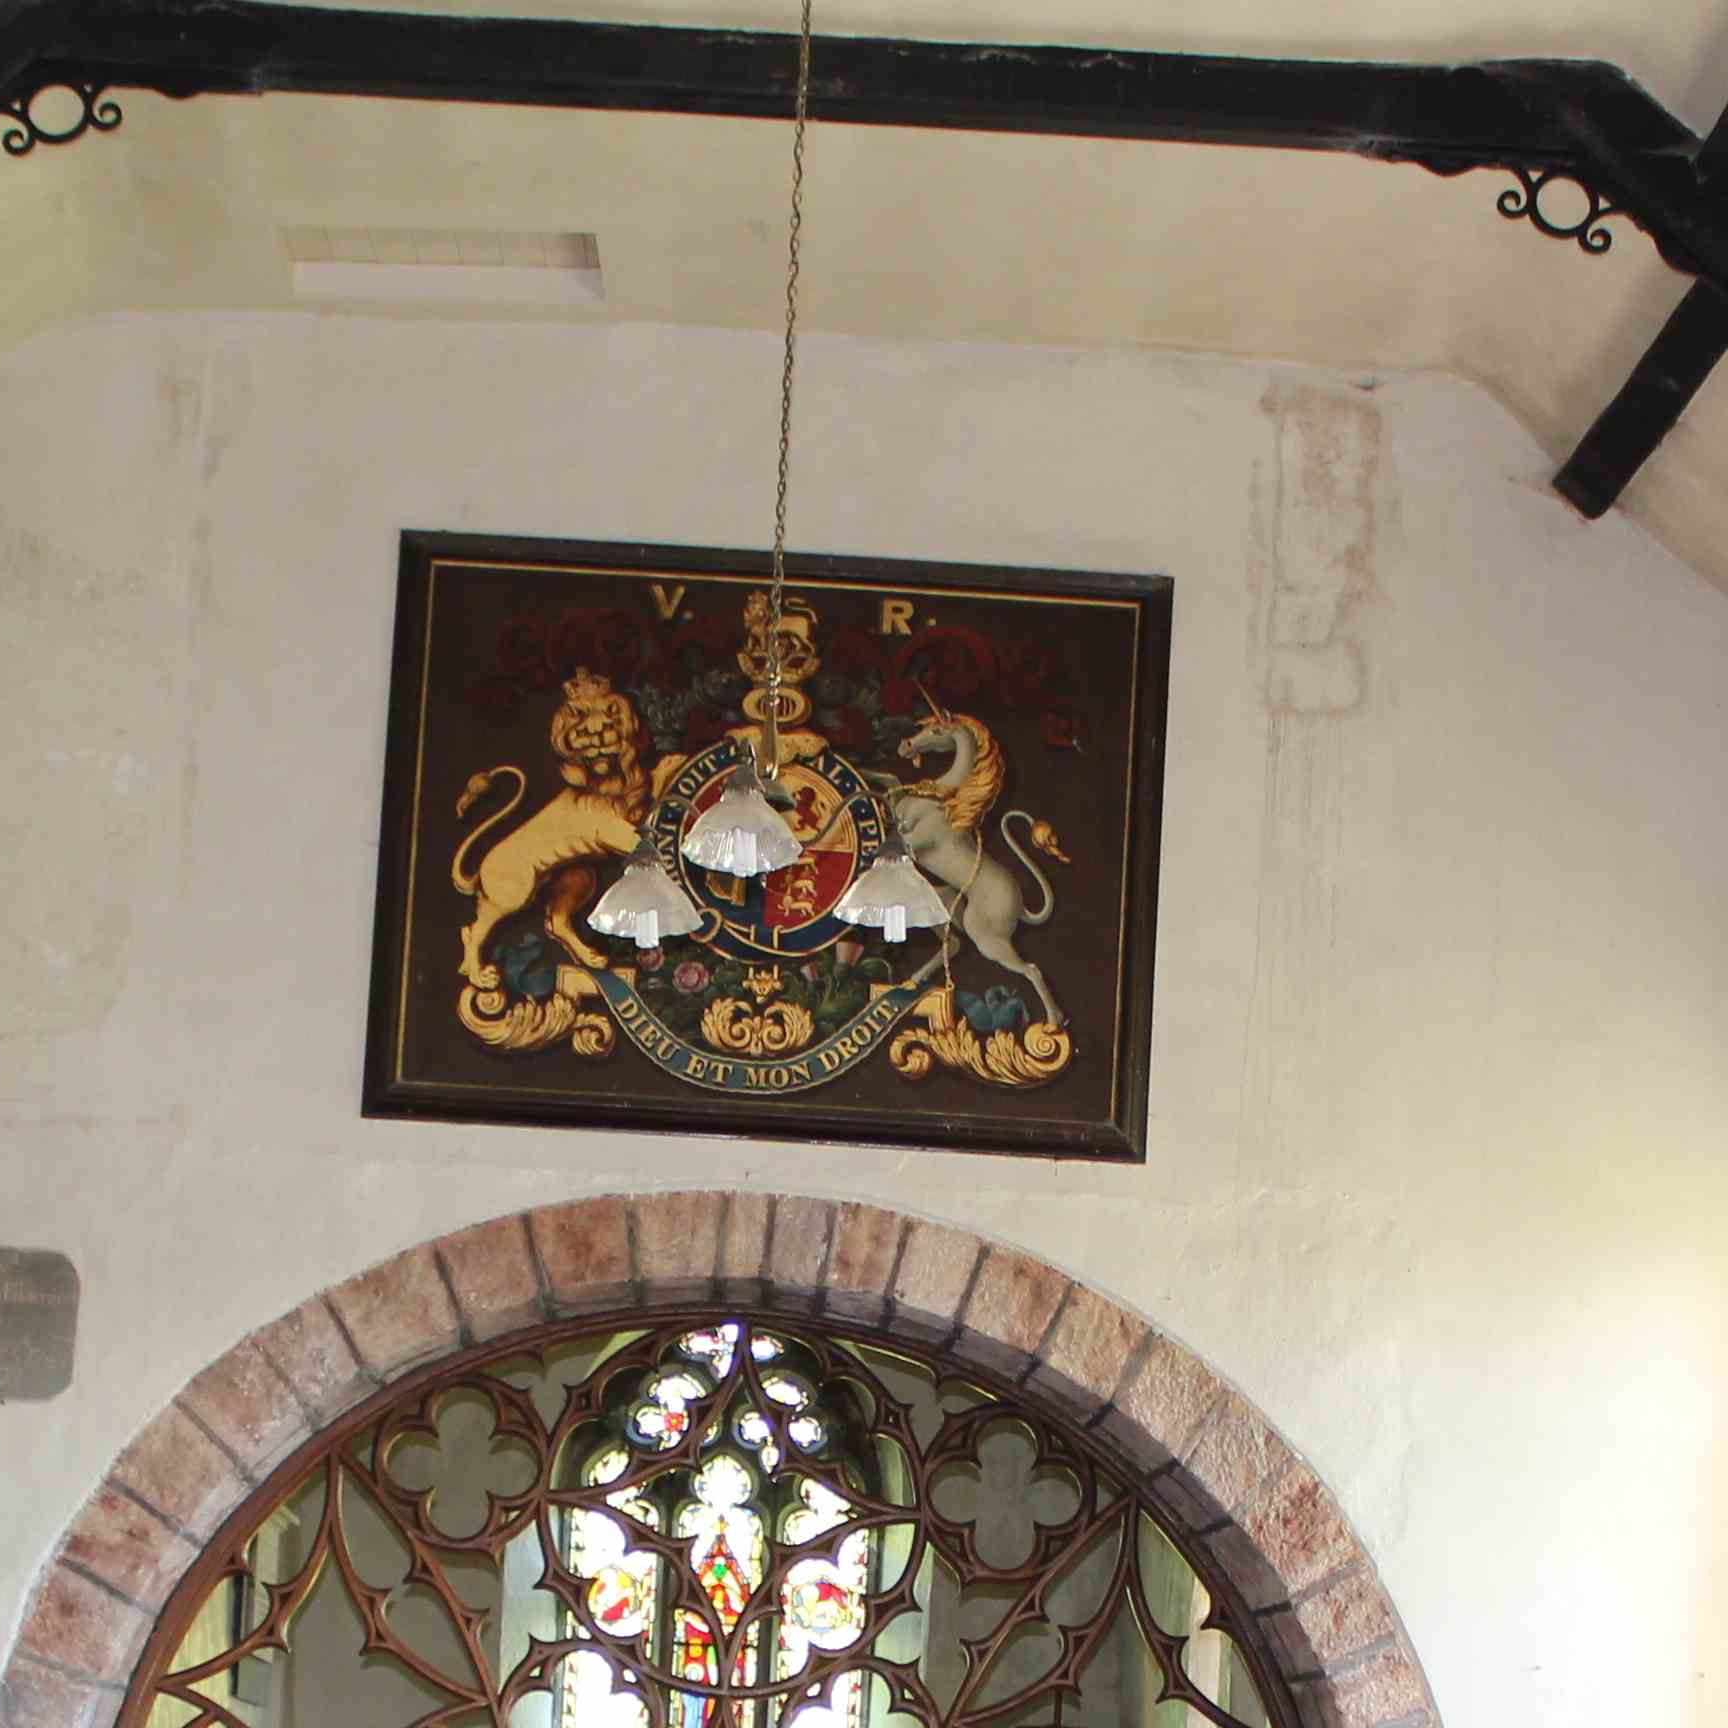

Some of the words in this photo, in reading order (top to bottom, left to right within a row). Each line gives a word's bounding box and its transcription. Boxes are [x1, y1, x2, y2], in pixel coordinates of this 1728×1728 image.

[617, 997, 680, 1061] DIEU
[684, 1055, 734, 1086] ET
[744, 1063, 812, 1088] MON
